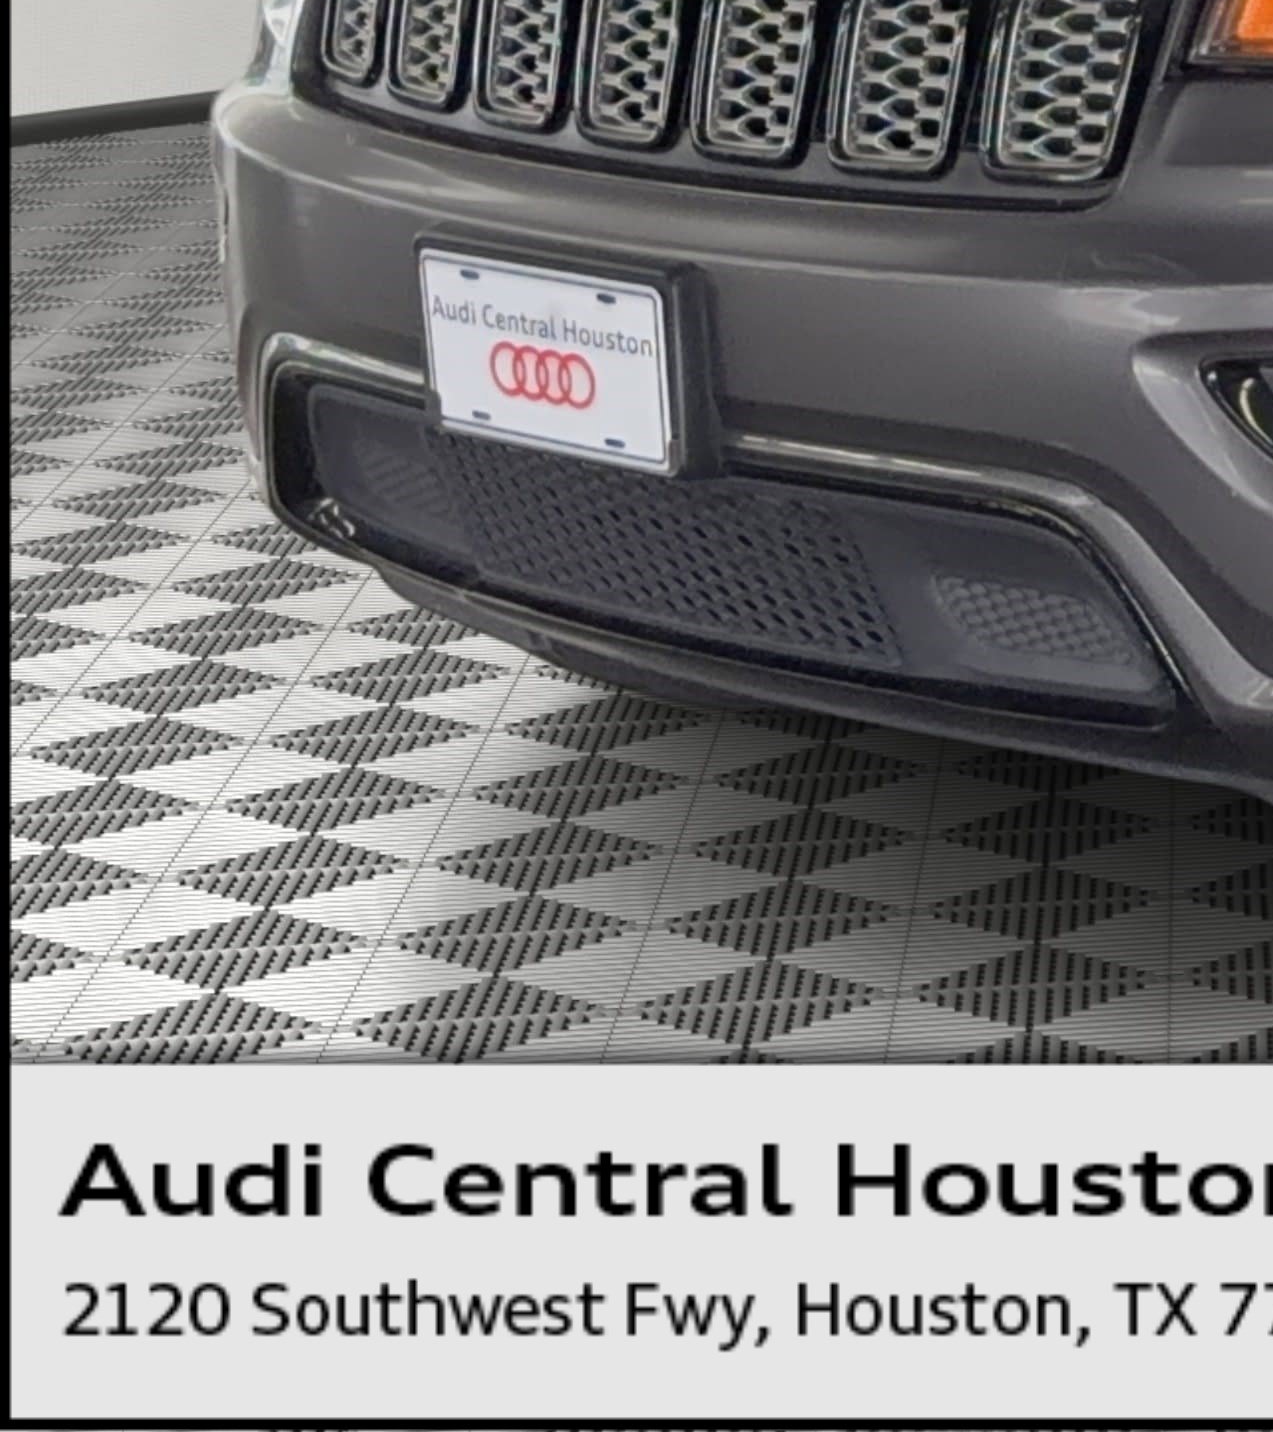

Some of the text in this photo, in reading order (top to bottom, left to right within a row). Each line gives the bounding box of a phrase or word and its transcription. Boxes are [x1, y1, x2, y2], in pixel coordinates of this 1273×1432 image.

[431, 294, 654, 358] Audi Central Houston
